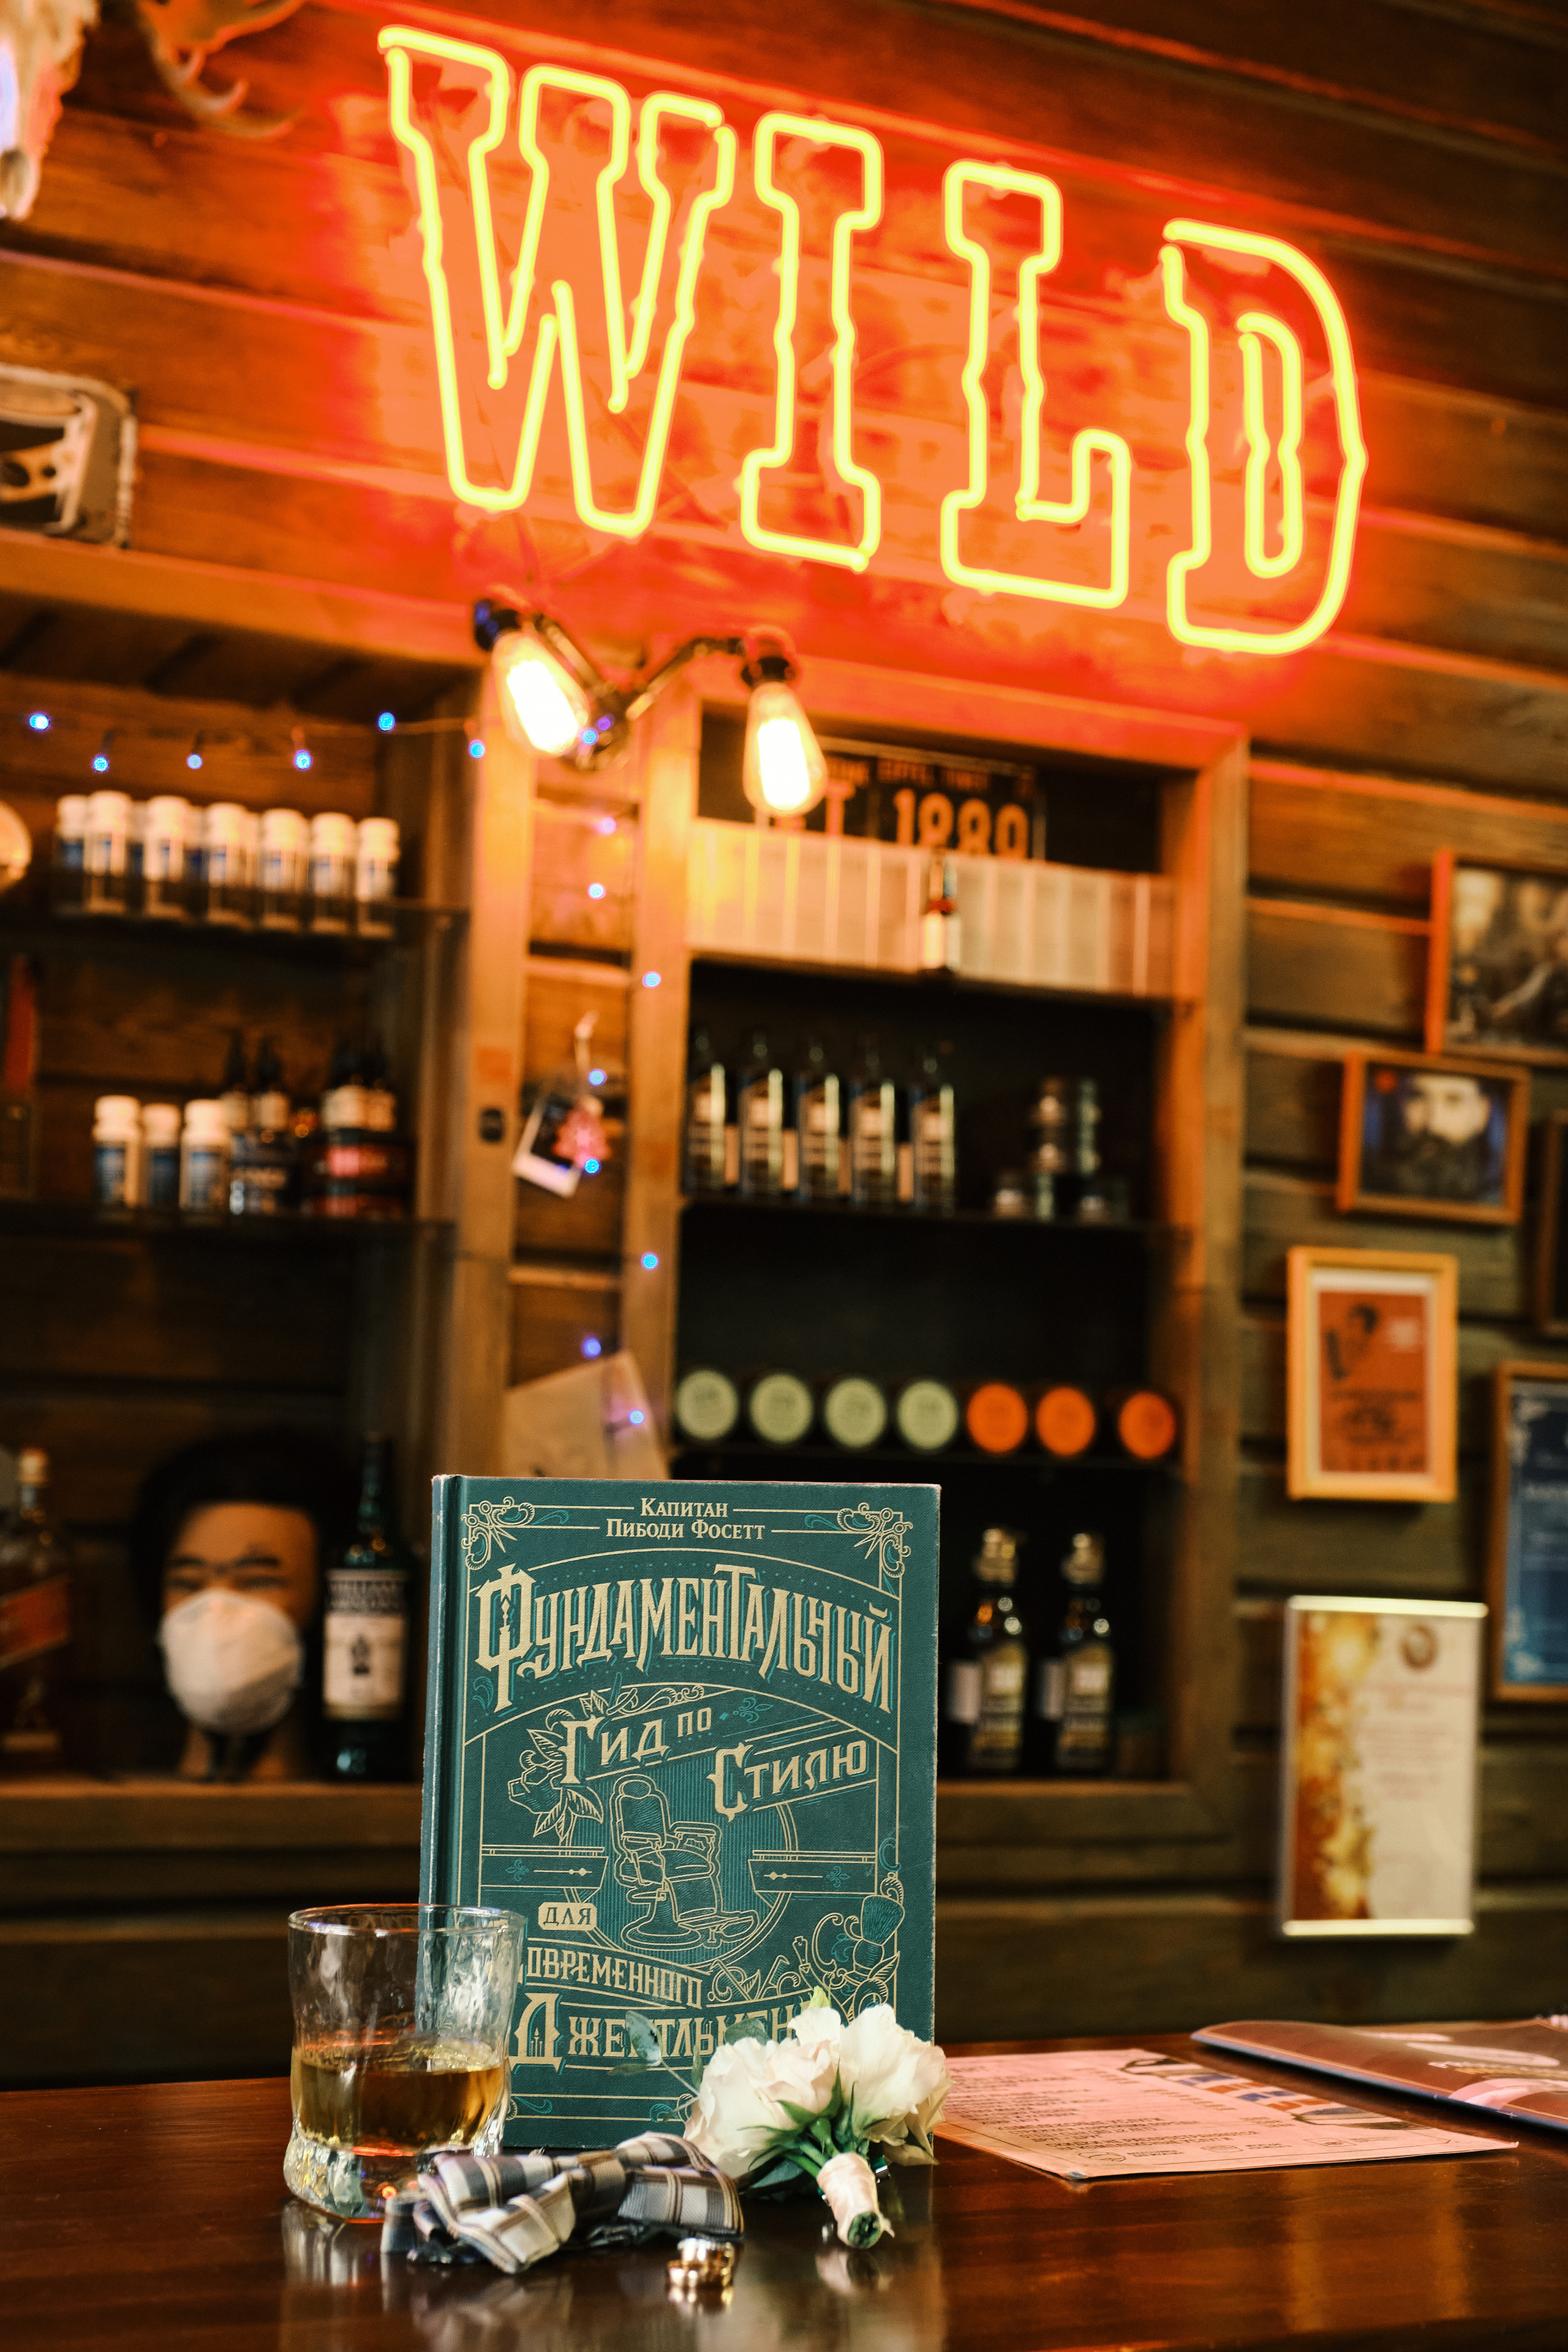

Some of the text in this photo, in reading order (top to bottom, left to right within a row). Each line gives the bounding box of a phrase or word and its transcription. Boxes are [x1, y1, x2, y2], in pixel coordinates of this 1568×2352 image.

[378, 25, 1368, 656] WILD
[606, 1518, 766, 1540] ПИБОДИ ФОСЕТТ
[640, 1498, 728, 1517] КАПИТАН
[475, 1563, 892, 1714] ФУНДАМЕНТАЛЬНЫЙ
[559, 1707, 712, 1784] ГИД ПО
[706, 1740, 867, 1822] СТИЛЮ
[543, 1907, 592, 1926] ДЛЯ
[517, 1947, 704, 2010] ОВРЕМЕННОГО
